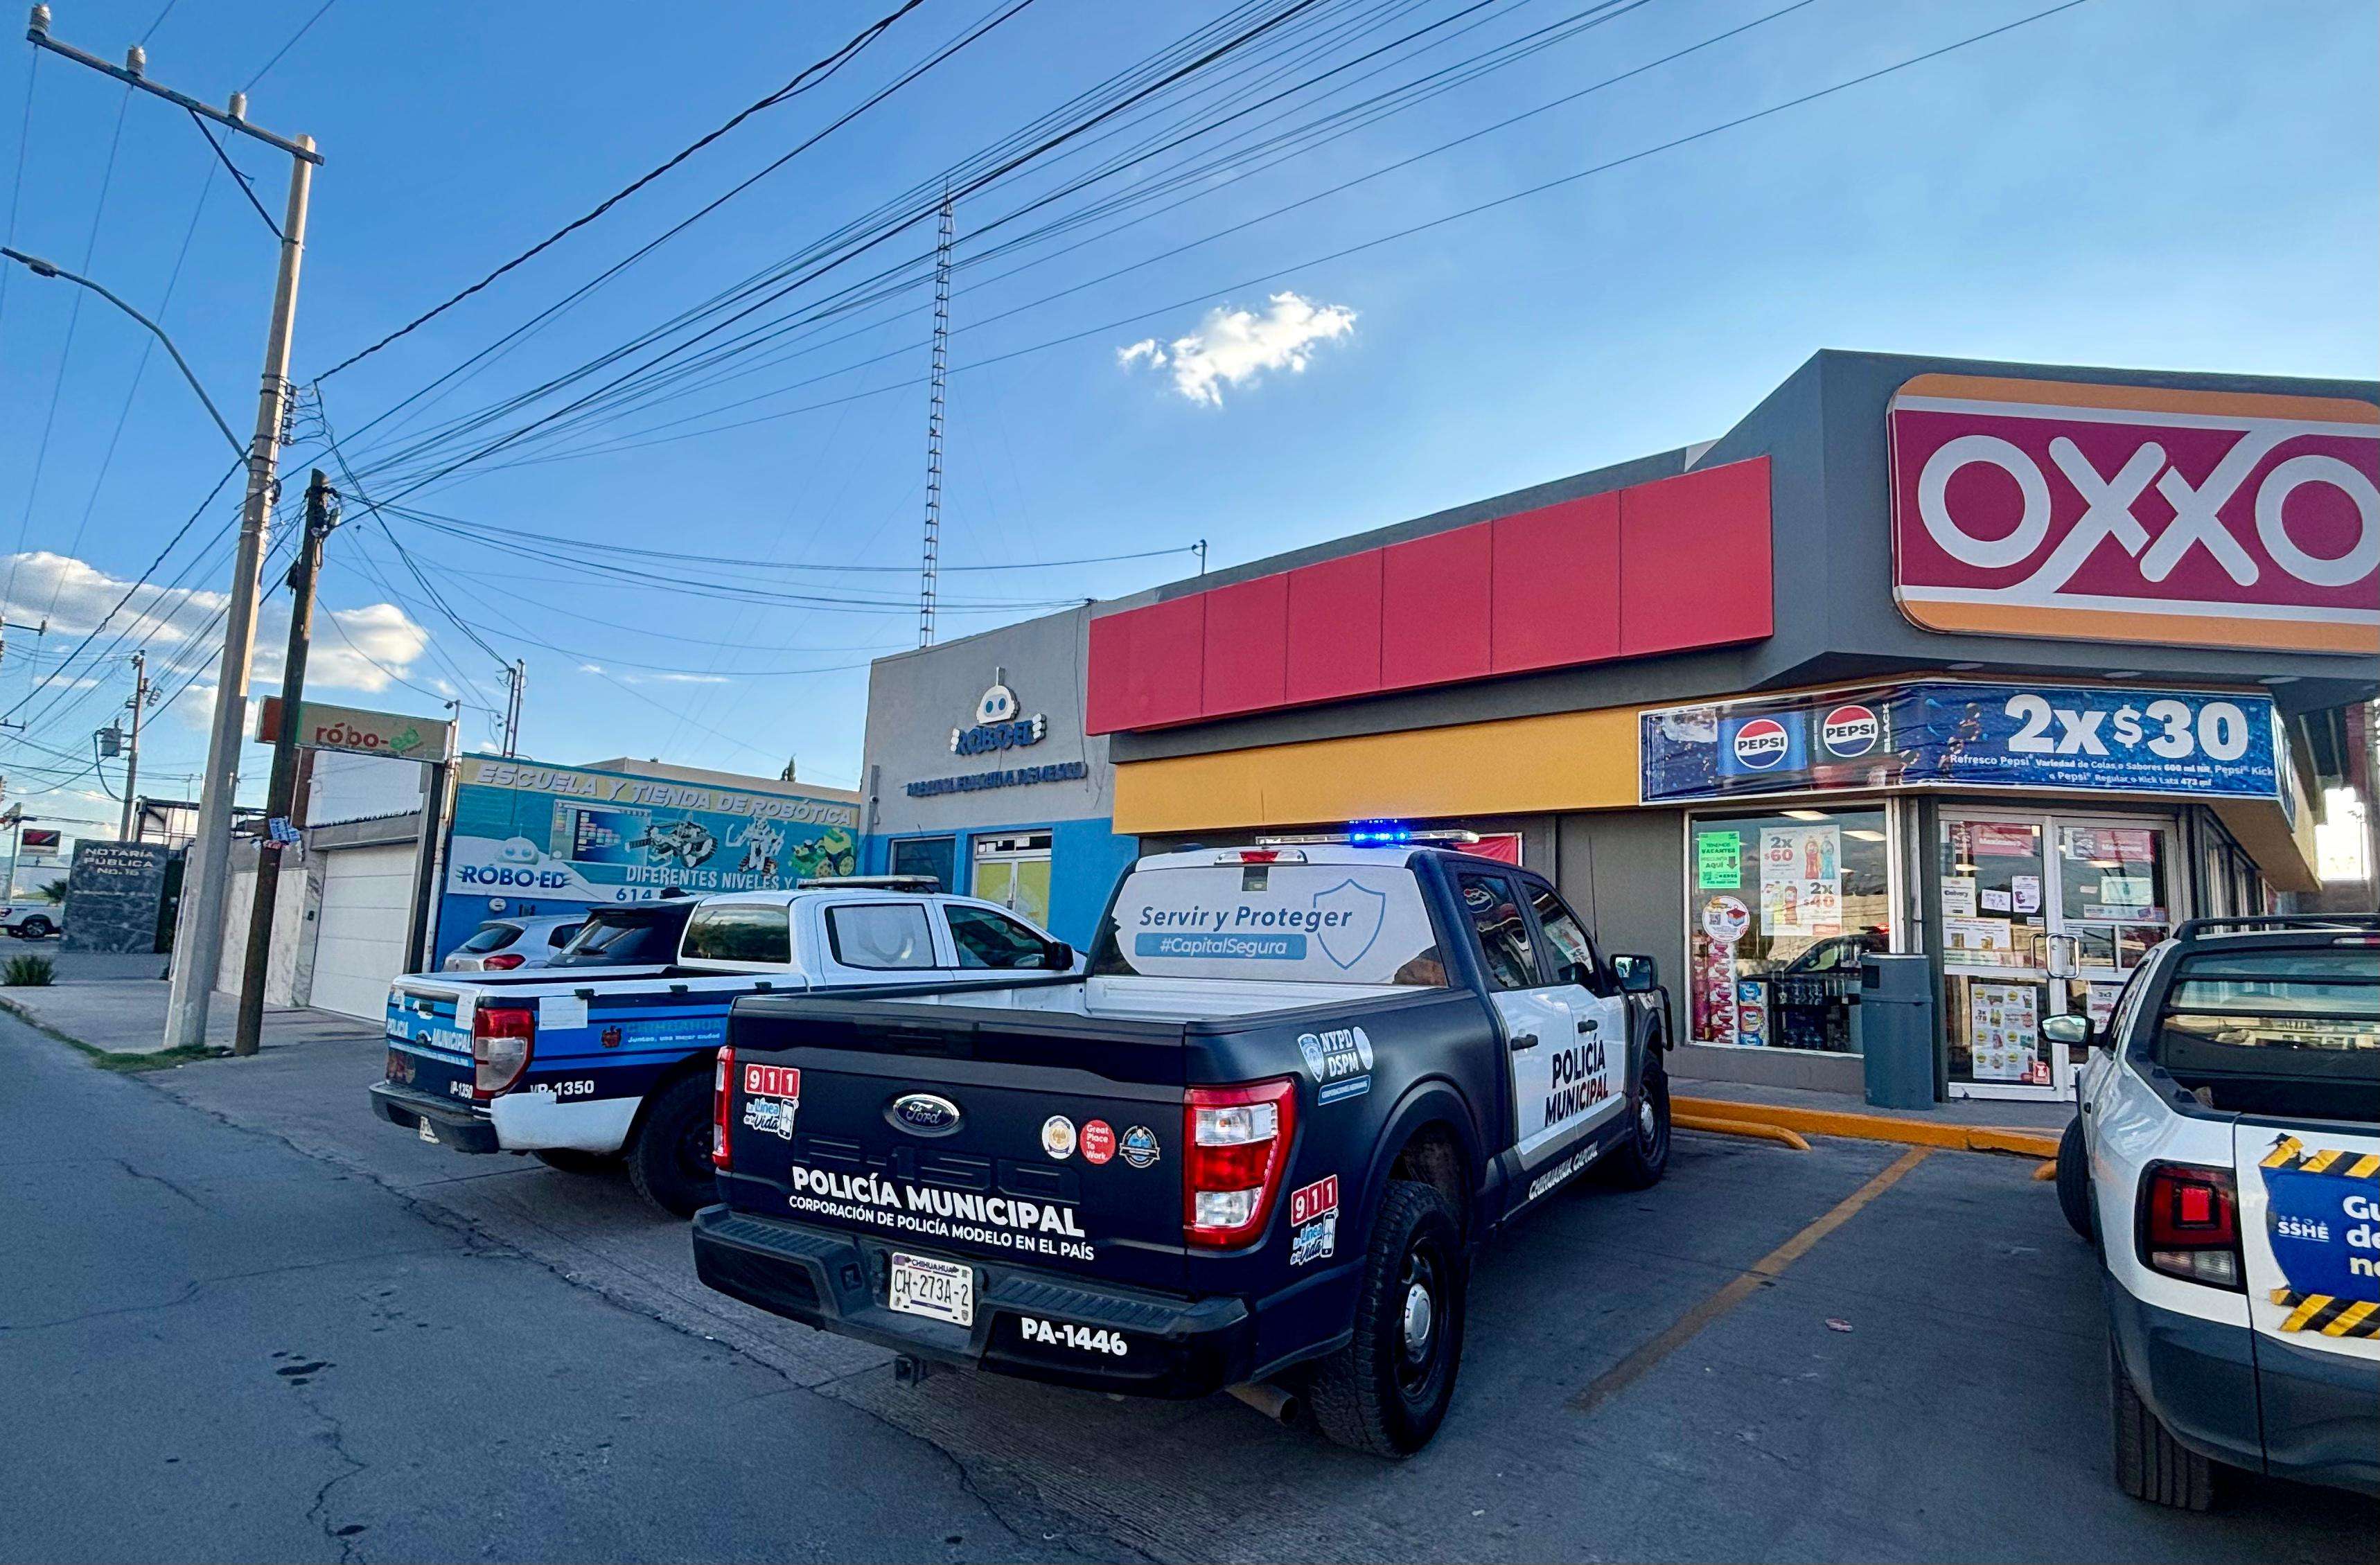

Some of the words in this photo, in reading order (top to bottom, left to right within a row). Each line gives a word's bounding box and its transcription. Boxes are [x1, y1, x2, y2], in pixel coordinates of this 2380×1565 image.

[1918, 434, 2380, 587] OXXO
[1826, 724, 1875, 739] PEPSI
[1738, 737, 1785, 751] PEPSI
[1950, 754, 1997, 765] Refresco
[2036, 759, 2076, 768] Variedad
[2078, 759, 2088, 768] de
[2126, 763, 2162, 771] Sabores
[2252, 766, 2273, 776] Kick
[2095, 774, 2128, 784] Regular
[477, 763, 597, 795] ESCUELA
[606, 779, 626, 802] Y
[632, 785, 711, 810] TIENDA
[717, 795, 748, 813] DE
[749, 798, 852, 826] ROBÓTICA
[1764, 849, 1794, 862] $60
[626, 866, 717, 888] DIFERENTES
[722, 872, 780, 890] NIVELES
[784, 876, 793, 889] Y
[616, 888, 652, 901] 614
[1140, 905, 1209, 927] Servir
[1213, 910, 1228, 932] y
[1235, 905, 1353, 932] Proteger
[1159, 936, 1287, 959] #CapitalSegura
[432, 1027, 472, 1053] MUNICIPAL
[1320, 1029, 1353, 1052] NYPD
[1328, 1052, 1359, 1077] DSPM
[1552, 1033, 1605, 1090] POLICÍA
[749, 1070, 794, 1093] 911
[1544, 1073, 1609, 1128] MUNICIPAL
[755, 1115, 779, 1130] Vida
[906, 1102, 942, 1124] Ford
[1086, 1124, 1109, 1134] Great
[1086, 1133, 1109, 1143] Place
[1086, 1142, 1095, 1150] To
[792, 1167, 902, 1208] POLICÍA
[906, 1185, 1085, 1238] MUNICIPAL
[1296, 1182, 1332, 1219] 911
[789, 1195, 874, 1223] CORPORACIÓN
[876, 1212, 894, 1227] DE
[897, 1214, 949, 1237] POLICÍA
[952, 1226, 1012, 1247] MODELO
[1015, 1235, 1035, 1251] EN
[1039, 1239, 1057, 1255] EL
[1061, 1241, 1095, 1261] PAÍS
[2278, 1221, 2329, 1239] SSHE
[912, 1259, 956, 1273] CHIHUAHUA
[894, 1269, 969, 1307] CH-273A-2
[1021, 1317, 1127, 1356] PA-1446
